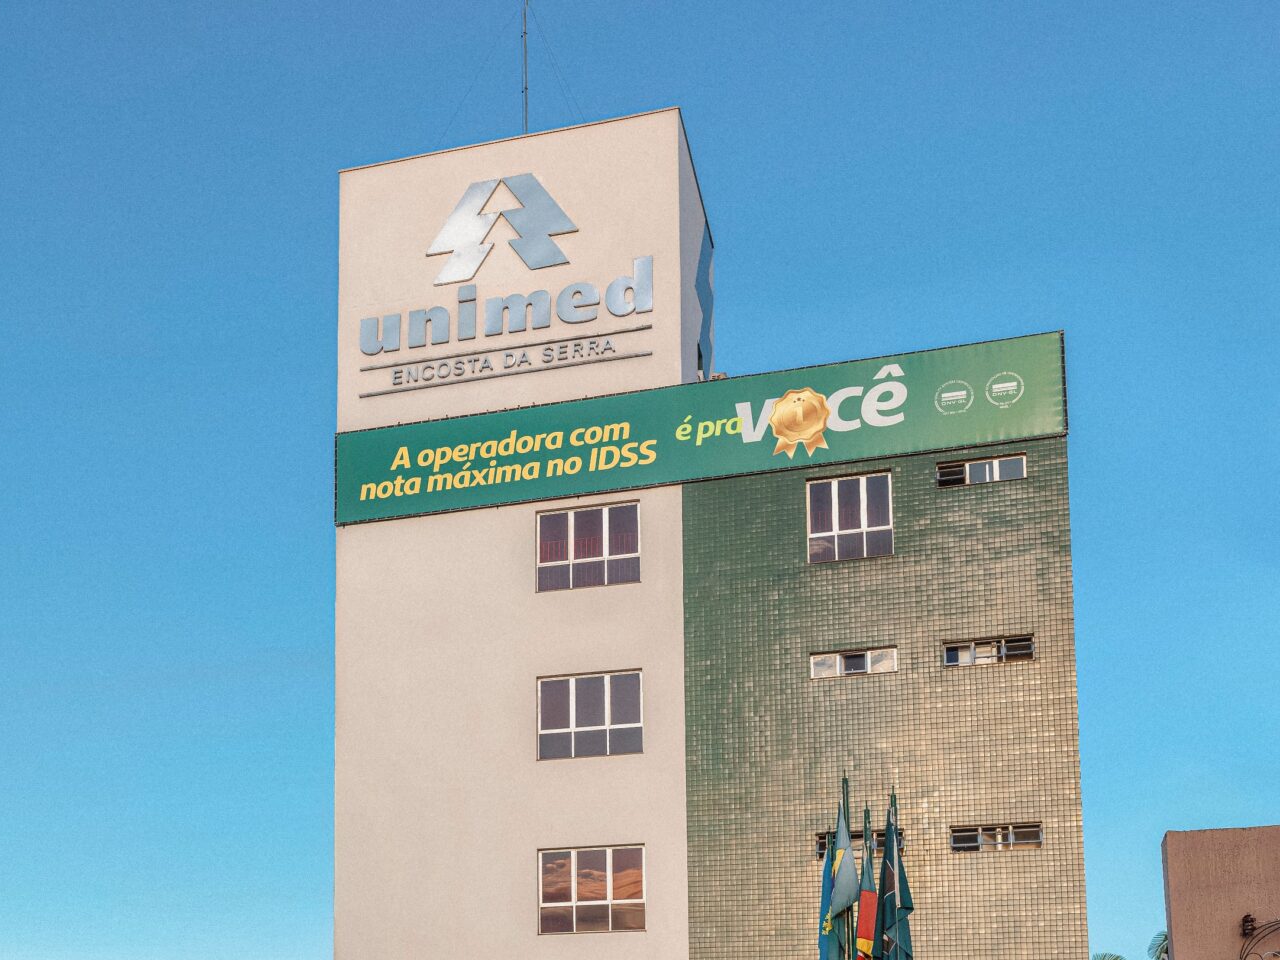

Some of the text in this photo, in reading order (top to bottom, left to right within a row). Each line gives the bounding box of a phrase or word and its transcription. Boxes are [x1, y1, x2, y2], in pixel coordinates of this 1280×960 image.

[360, 256, 653, 356] unimed
[392, 339, 616, 386] ENCOSTA DA SERRA
[675, 364, 908, 446] é pra vcê
[359, 439, 657, 501] nota máxima no IDSS
[390, 421, 630, 472] A operadora com
